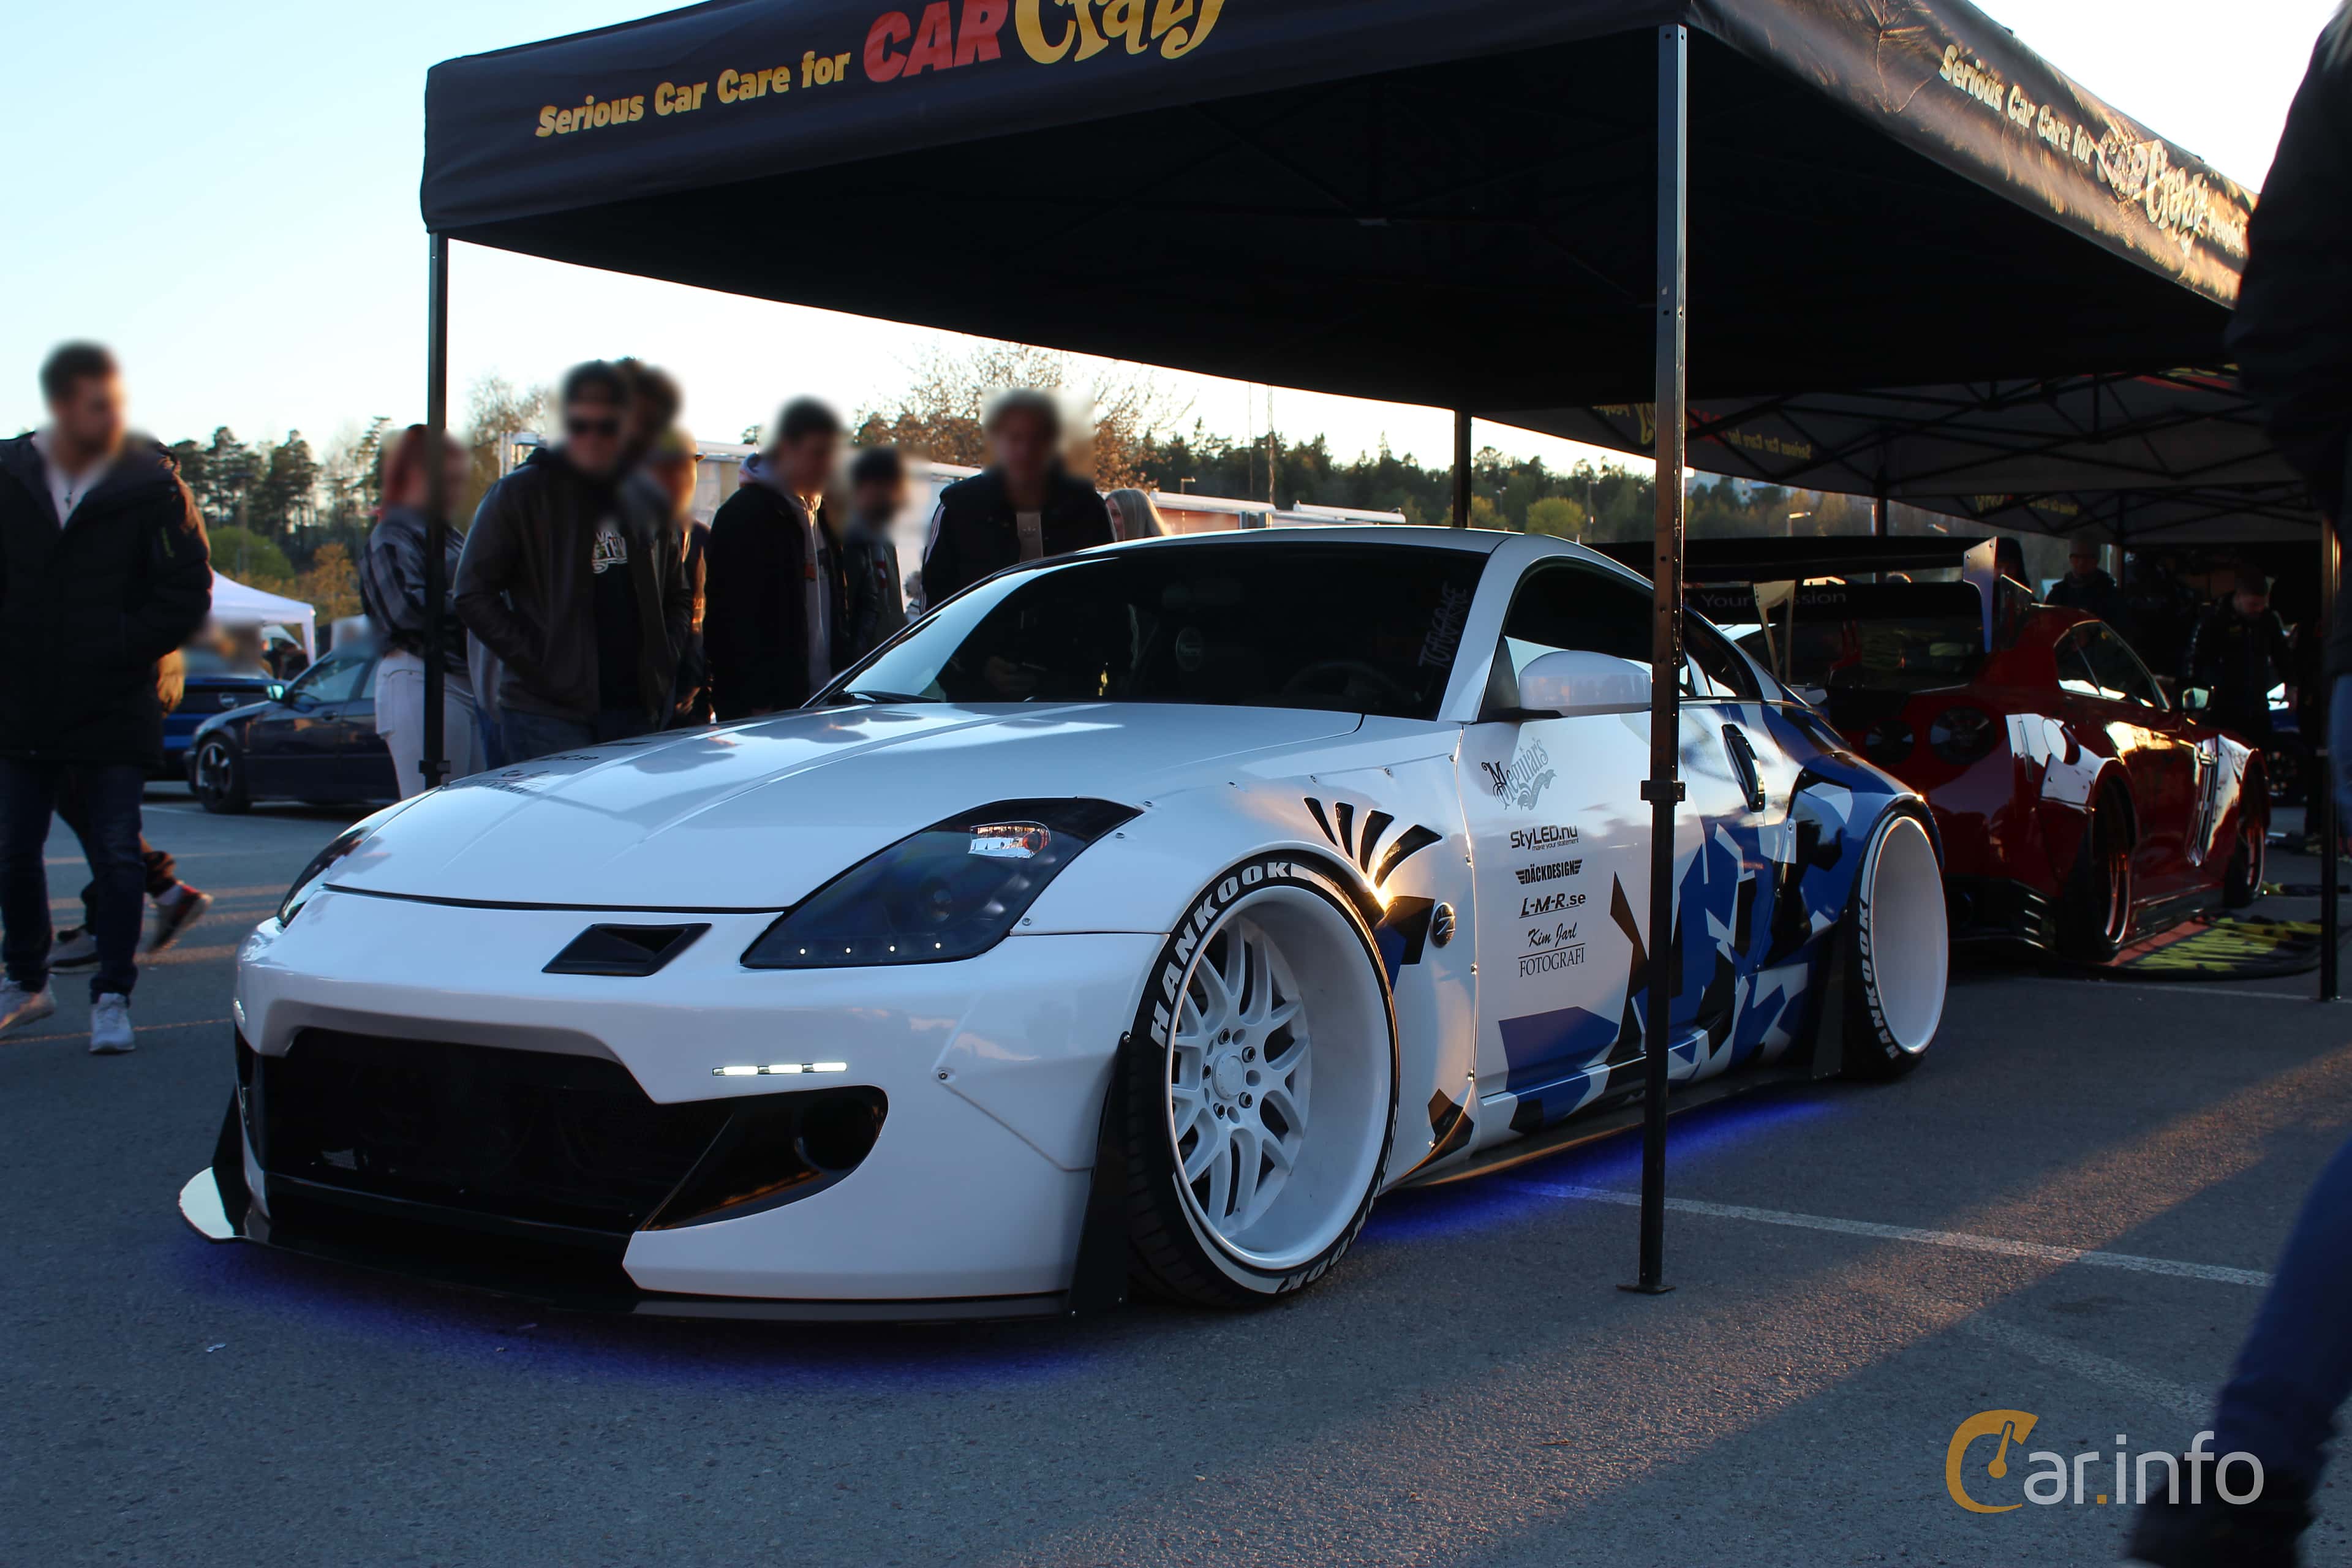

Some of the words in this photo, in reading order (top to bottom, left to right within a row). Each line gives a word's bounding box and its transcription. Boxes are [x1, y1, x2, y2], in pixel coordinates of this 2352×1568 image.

[535, 95, 644, 138] Serious
[655, 81, 707, 116] Car
[717, 66, 791, 104] Care
[801, 51, 851, 88] for
[863, 0, 1009, 83] CAR
[1939, 44, 2005, 111] Serious
[2007, 83, 2037, 129] Car
[2037, 105, 2071, 151] Care
[2073, 124, 2094, 165] for
[1510, 825, 1578, 850] StyLED.nu
[1525, 860, 1575, 884] DÄCKDESIGN
[1520, 893, 1586, 917] L-M-R.se
[1528, 928, 1552, 948] Kim
[1555, 921, 1577, 948] Jarl
[1150, 862, 1289, 1049] HANKOOK
[1520, 947, 1585, 978] FOTOGRAFI
[1858, 898, 1900, 1060] HANKOOK
